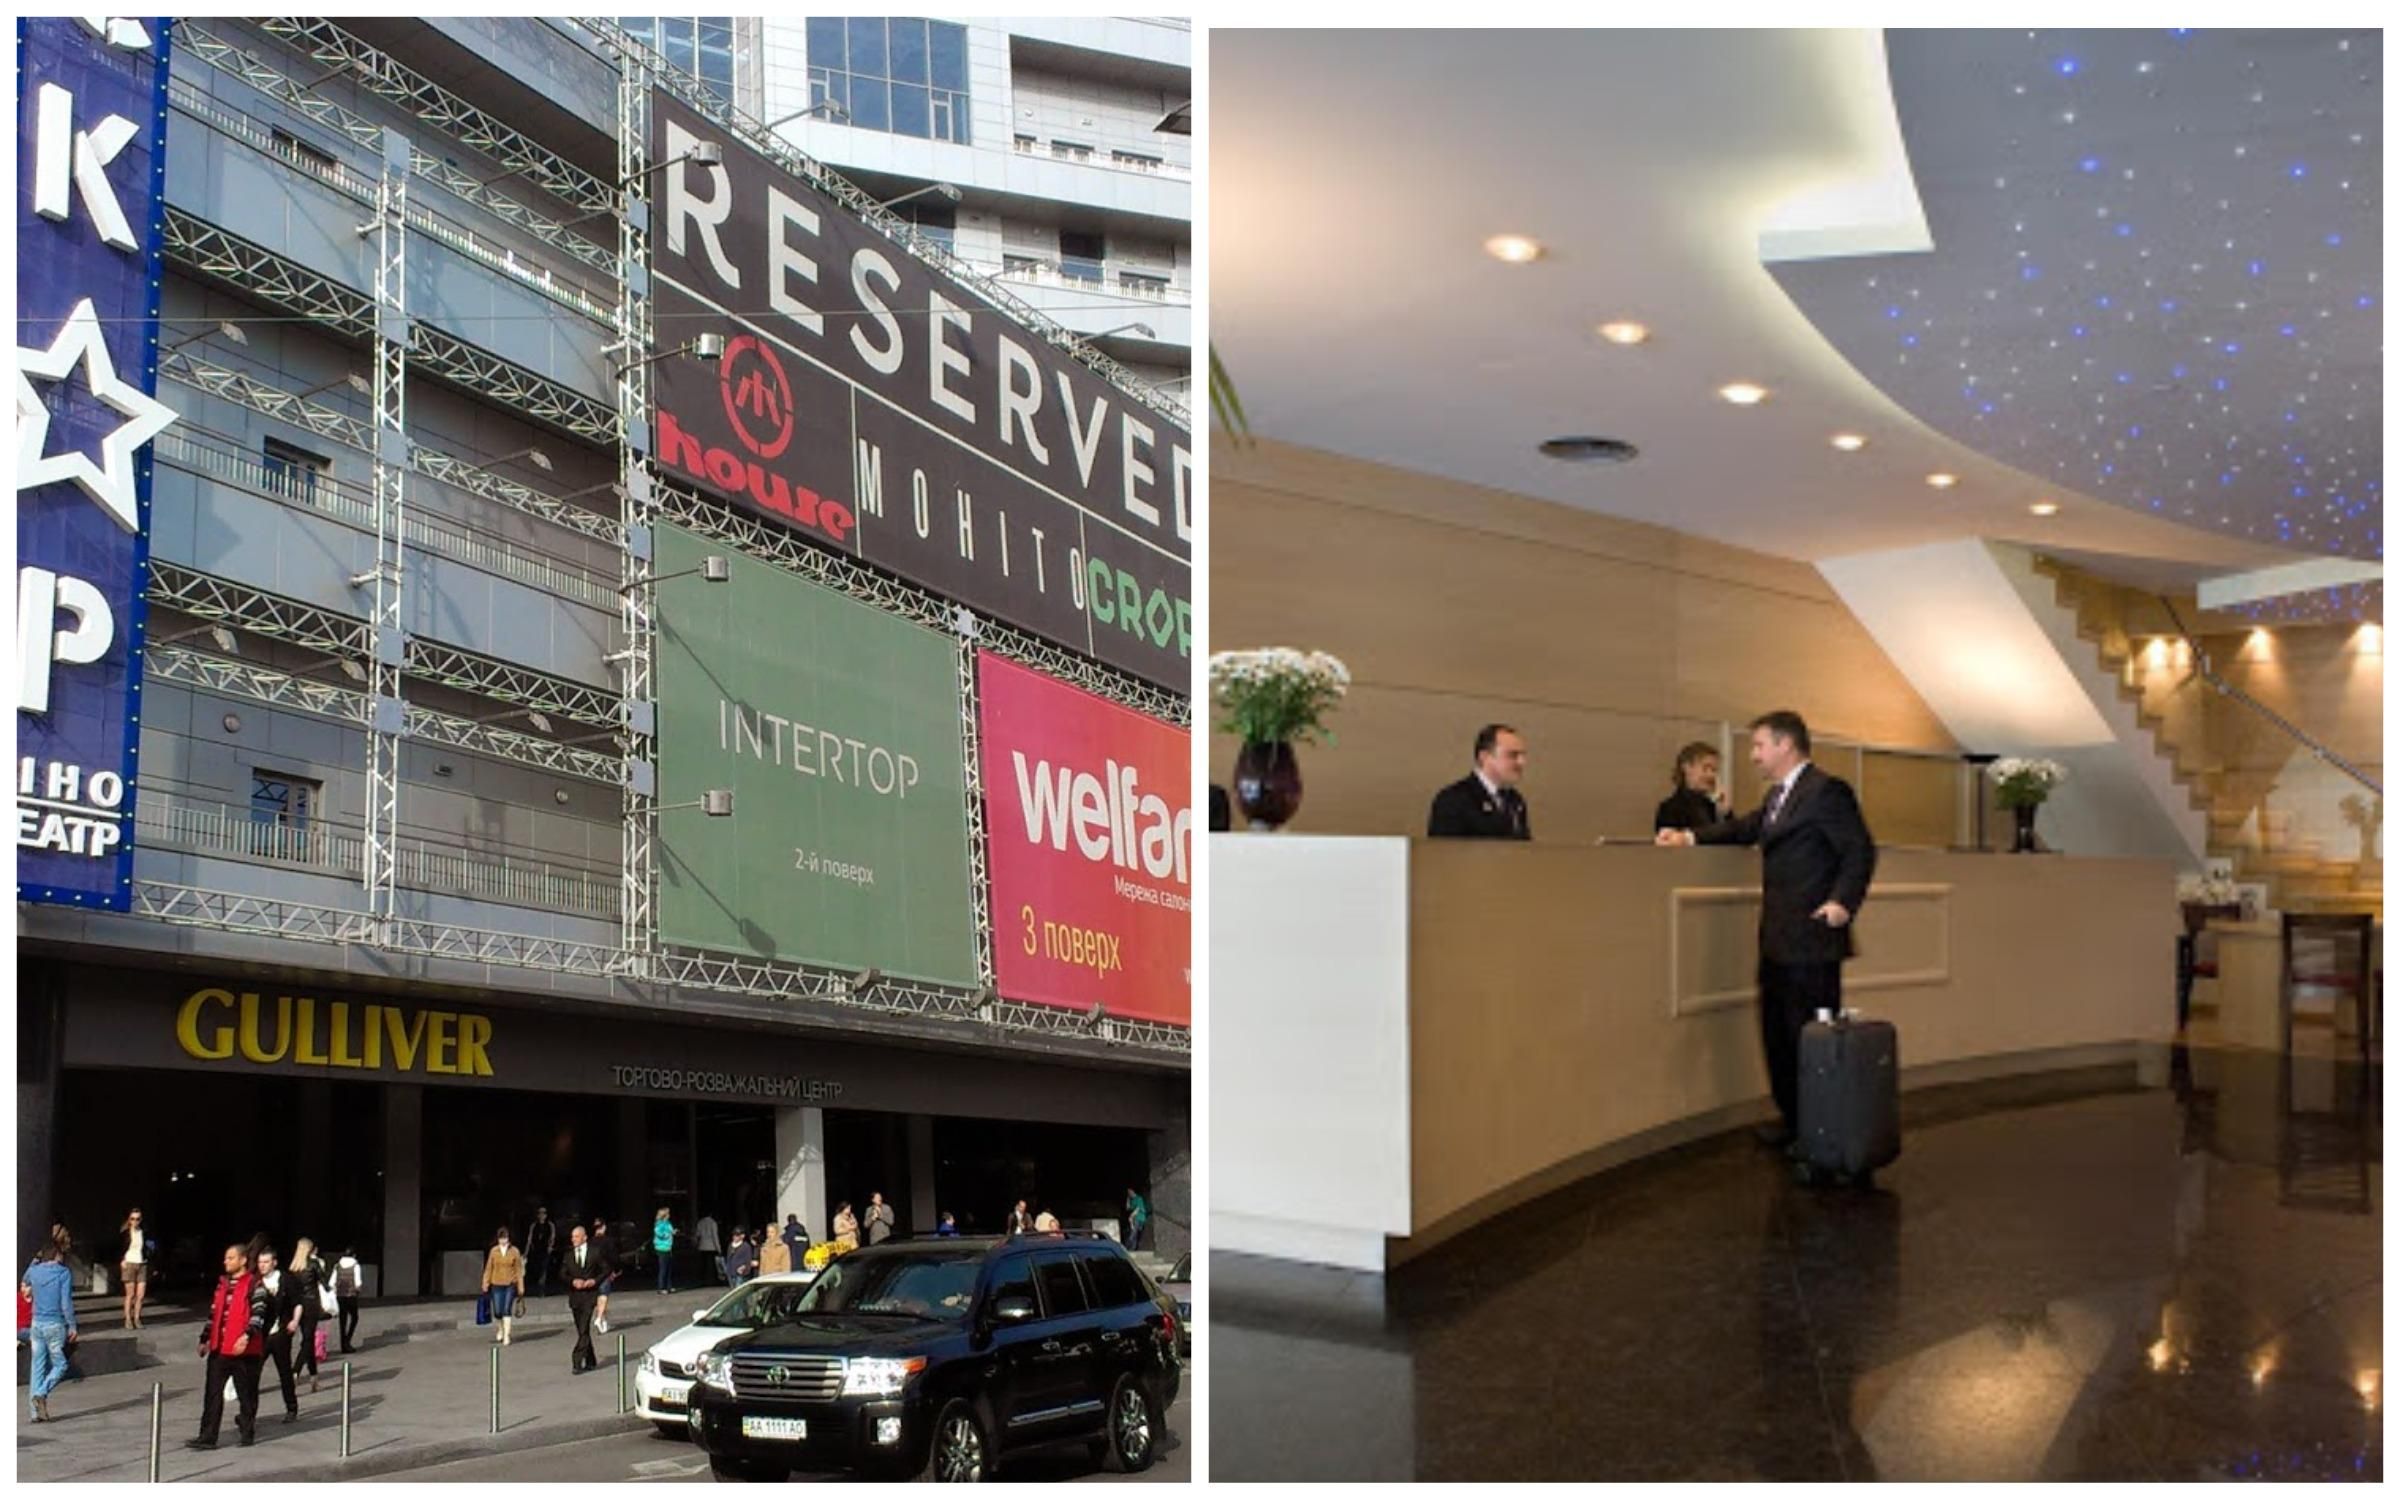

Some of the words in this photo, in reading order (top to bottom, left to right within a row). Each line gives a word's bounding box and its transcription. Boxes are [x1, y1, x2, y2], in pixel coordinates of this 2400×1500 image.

[667, 119, 1191, 544] RESERVED
[657, 410, 855, 541] house
[859, 439, 1085, 610] MOHITO
[719, 700, 920, 799] INTERTOP
[1012, 750, 1191, 884] welfar
[823, 859, 874, 887] поверх
[1114, 874, 1159, 904] Мережа
[1022, 905, 1036, 956] 3
[1044, 922, 1122, 979] поверх
[176, 988, 494, 1077] GULLIVER
[803, 1081, 842, 1101] ЦЕНТР
